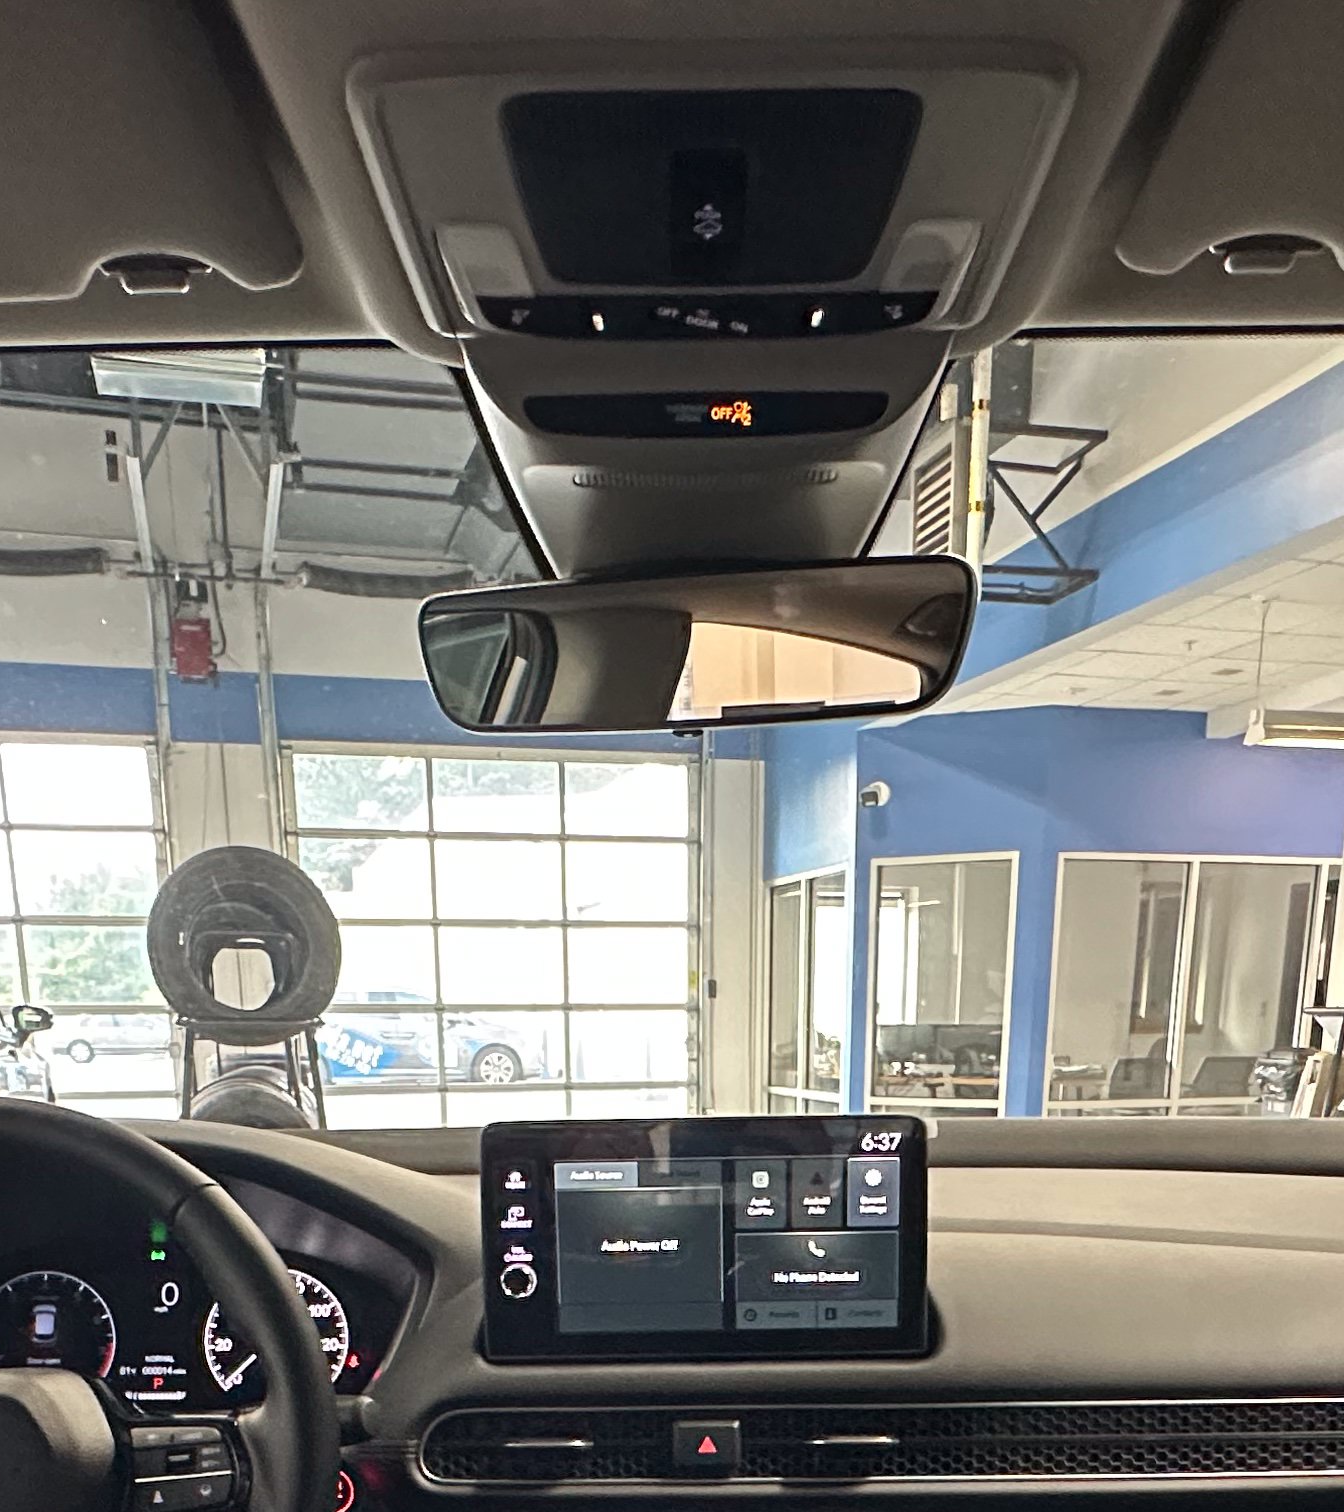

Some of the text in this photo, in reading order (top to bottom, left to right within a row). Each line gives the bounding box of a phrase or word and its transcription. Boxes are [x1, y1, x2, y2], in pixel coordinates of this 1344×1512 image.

[711, 407, 734, 420] OFF
[861, 1132, 902, 1151] 6:37
[160, 1282, 180, 1307] 0
[308, 1304, 332, 1318] 100
[214, 1338, 233, 1352] 20
[154, 1377, 165, 1390] P
